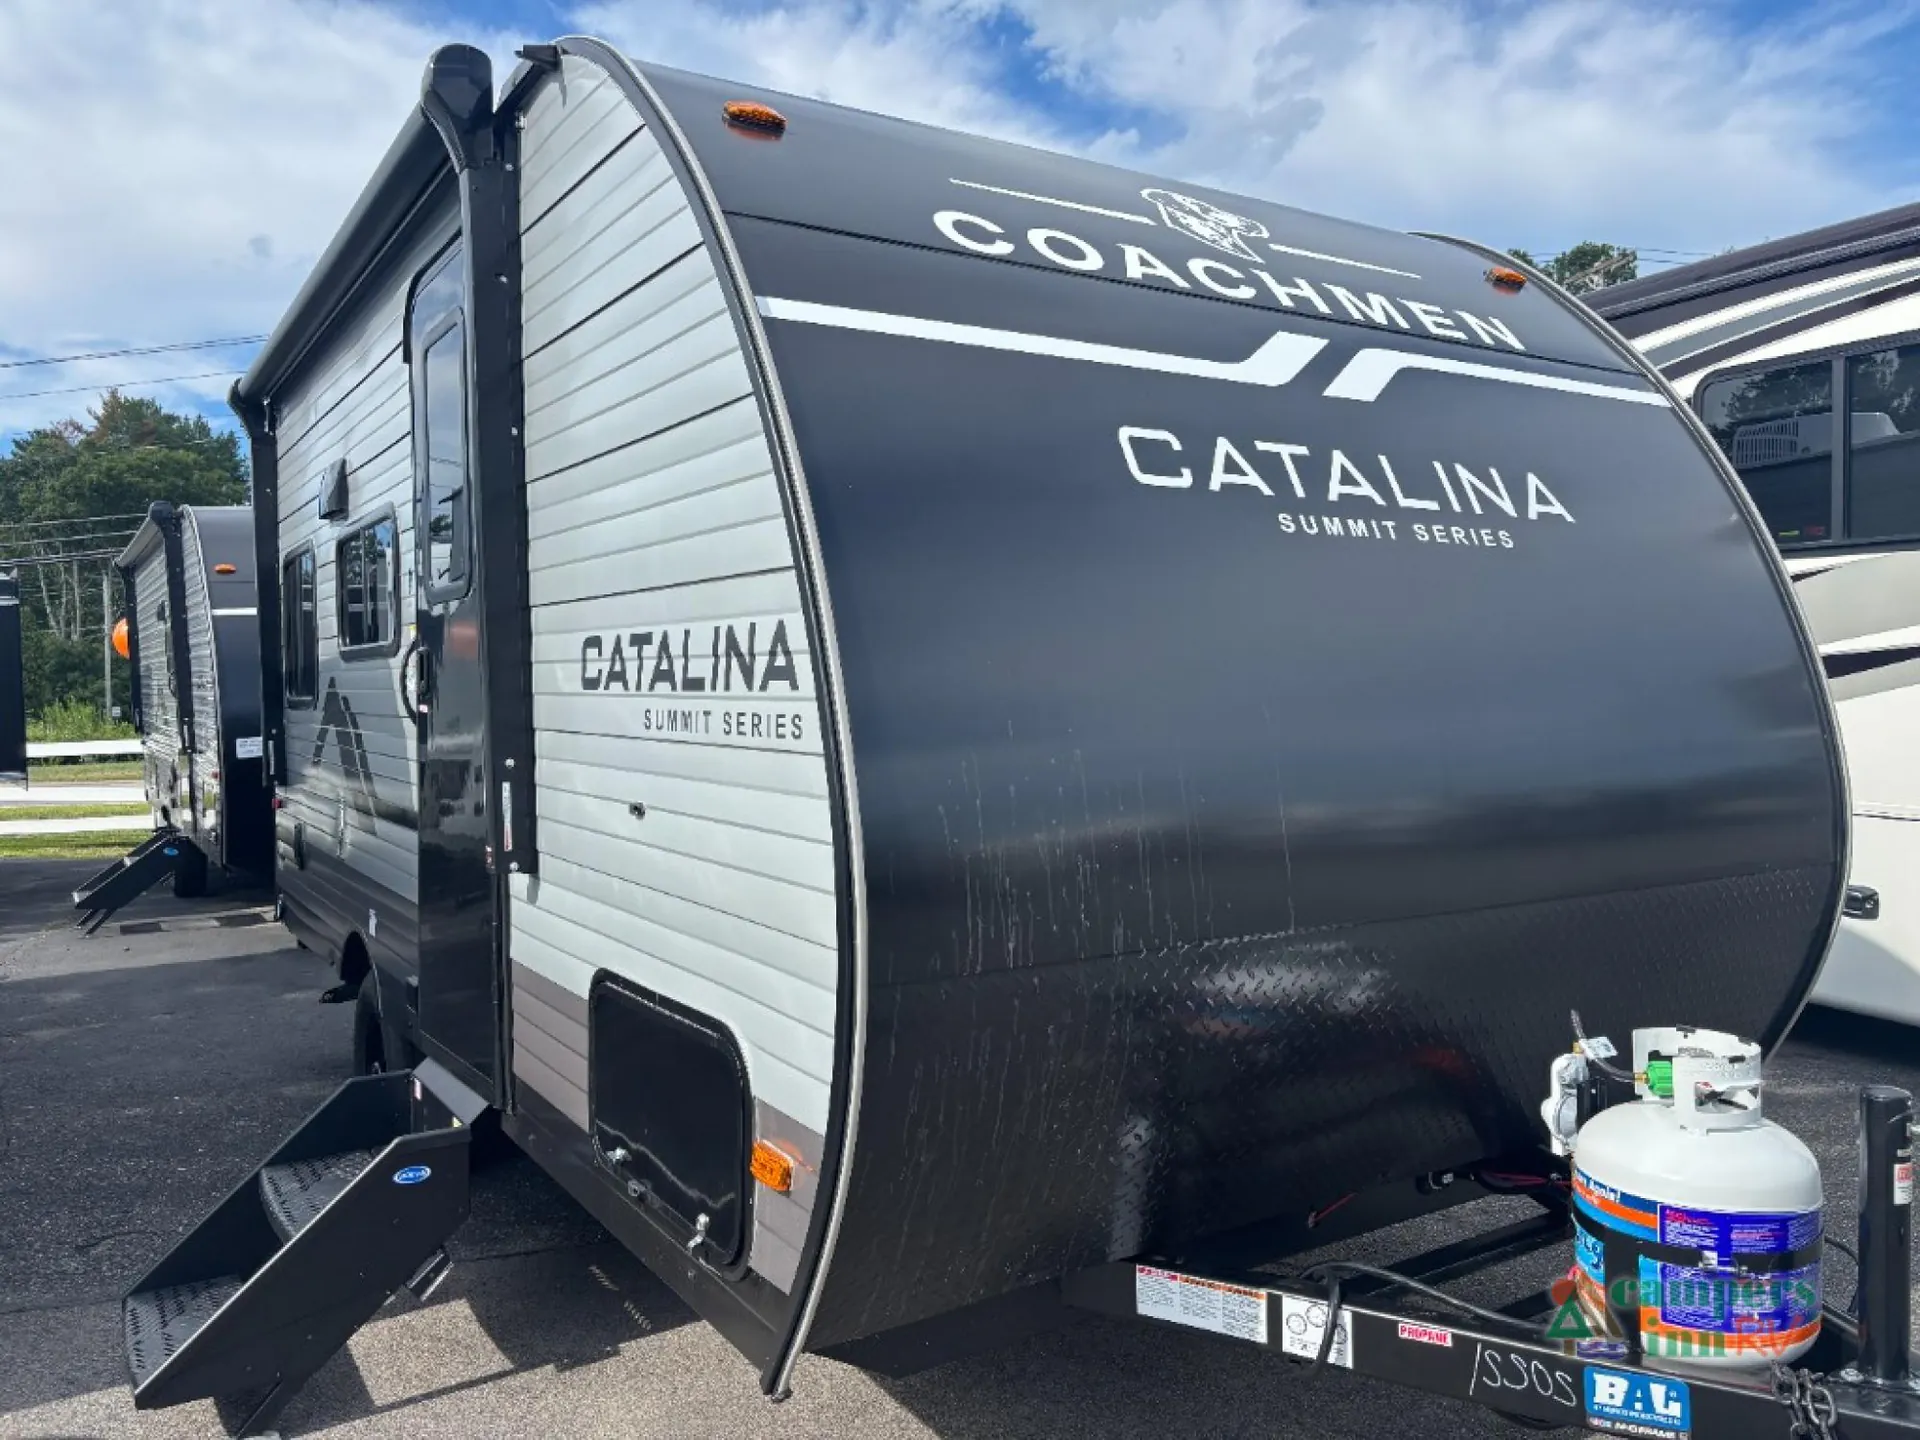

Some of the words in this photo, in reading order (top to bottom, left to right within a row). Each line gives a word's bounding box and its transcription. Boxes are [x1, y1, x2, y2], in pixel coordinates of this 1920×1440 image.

[933, 210, 1525, 351] COACHMEN
[1118, 425, 1575, 523] CATALINA
[1278, 513, 1398, 541] SUMMIT
[1413, 522, 1515, 549] SERIES
[580, 618, 800, 692] CATALINA
[644, 708, 712, 734] SUMMIT
[723, 711, 803, 740] SERIES
[1400, 1324, 1449, 1345] PROPANE
